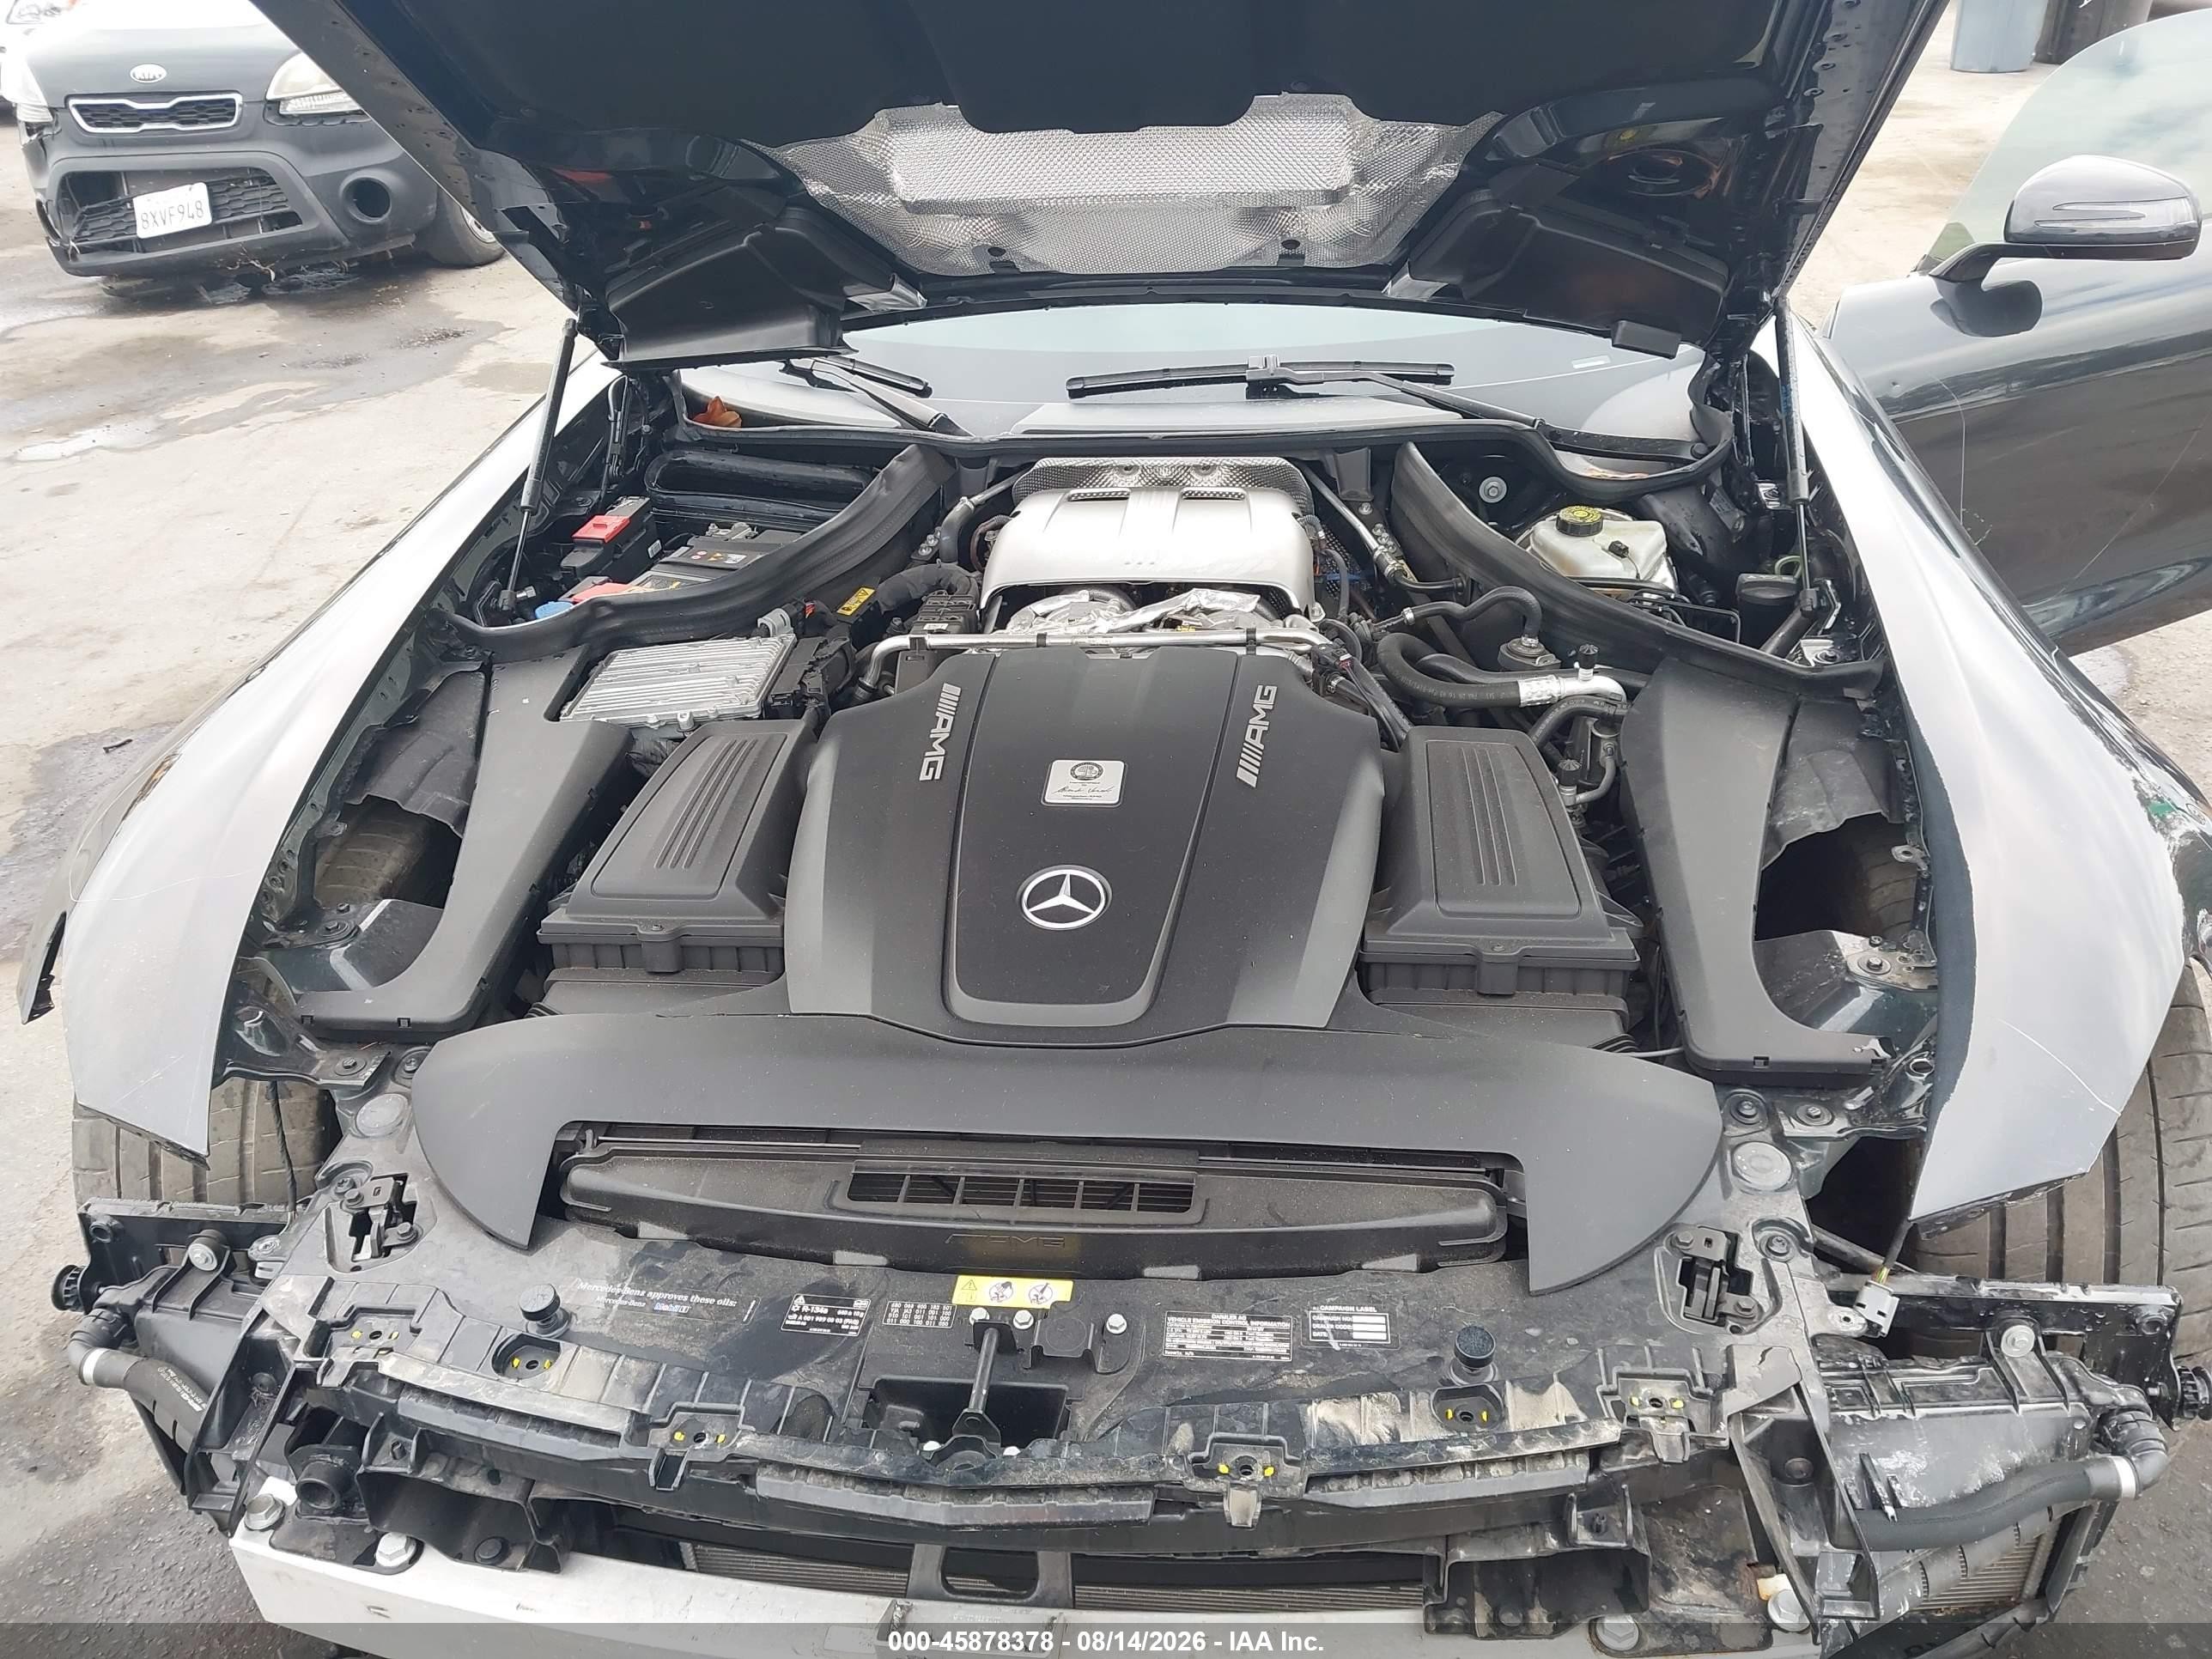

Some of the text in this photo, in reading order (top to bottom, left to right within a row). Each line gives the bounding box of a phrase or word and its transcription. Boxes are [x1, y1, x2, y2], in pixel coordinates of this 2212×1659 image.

[141, 200, 204, 229] 8XVF948
[1243, 684, 1278, 753] AMG
[920, 709, 955, 781] AMG
[578, 1283, 646, 1297] Mercedes-Benz
[647, 1291, 688, 1303] approves
[690, 1294, 715, 1305] these
